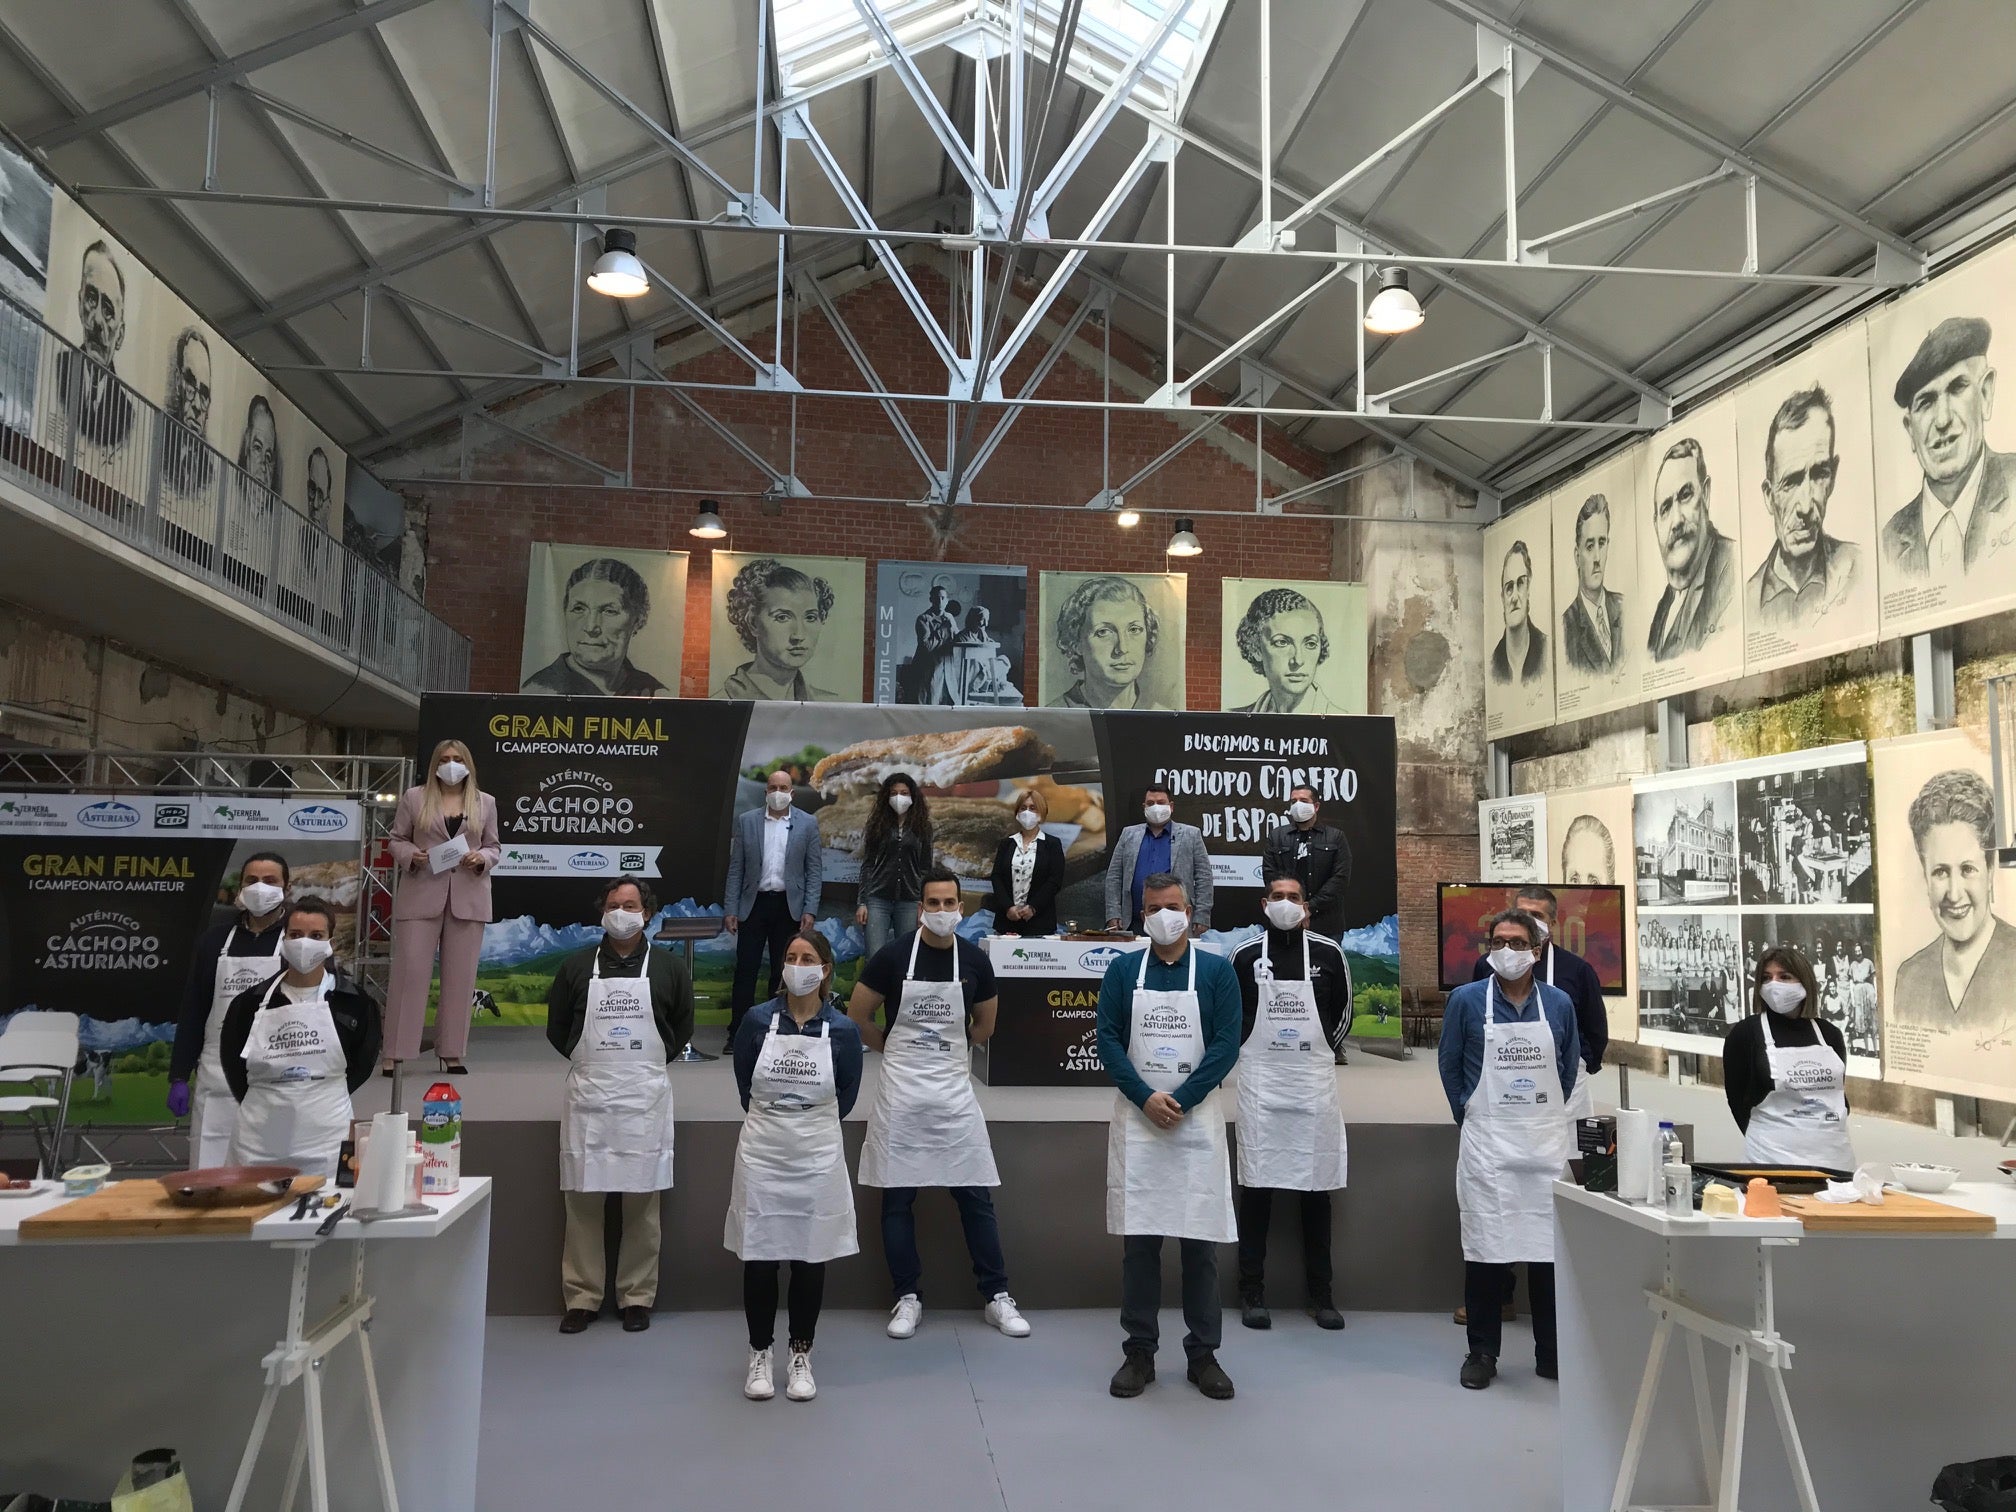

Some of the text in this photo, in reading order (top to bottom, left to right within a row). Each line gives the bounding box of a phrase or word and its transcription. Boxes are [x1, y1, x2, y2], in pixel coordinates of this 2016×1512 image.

[488, 715, 669, 741] GRAN FINAL
[501, 742, 594, 755] CAMPEONATO
[596, 744, 659, 756] AMATEUR
[1184, 733, 1328, 756] BUSCAMOS EL MEJOR
[539, 768, 613, 792] AUTÉNTICO
[515, 796, 633, 815] CACHOPO
[83, 811, 135, 823] ASTURIANA
[233, 809, 261, 817] TERNERA
[292, 815, 344, 827] ASTURIANA
[512, 816, 634, 834] ASTURIANO
[1202, 812, 1222, 838] DE
[23, 854, 195, 878] GRAN FINAL
[571, 858, 606, 867] ASTURIANA
[28, 879, 185, 892] I CAMPEONATO AMATEUR
[69, 910, 140, 932] AUTÉNTICO
[46, 935, 159, 951] CACHOPO
[1028, 951, 1051, 959] TERNERA
[43, 954, 159, 970] ASTURIANO
[1082, 958, 1112, 967] ASTUR
[600, 998, 640, 1006] CACHOPO
[1047, 990, 1101, 1007] GRAN
[1056, 1010, 1098, 1019] CAMPEON
[1143, 1013, 1187, 1022] CACHOPO
[269, 1030, 319, 1043] CACHOPO
[1497, 1046, 1541, 1054] CACHOPO
[773, 1059, 817, 1069] CACHOPO
[1786, 1068, 1832, 1077] CACHOPO
